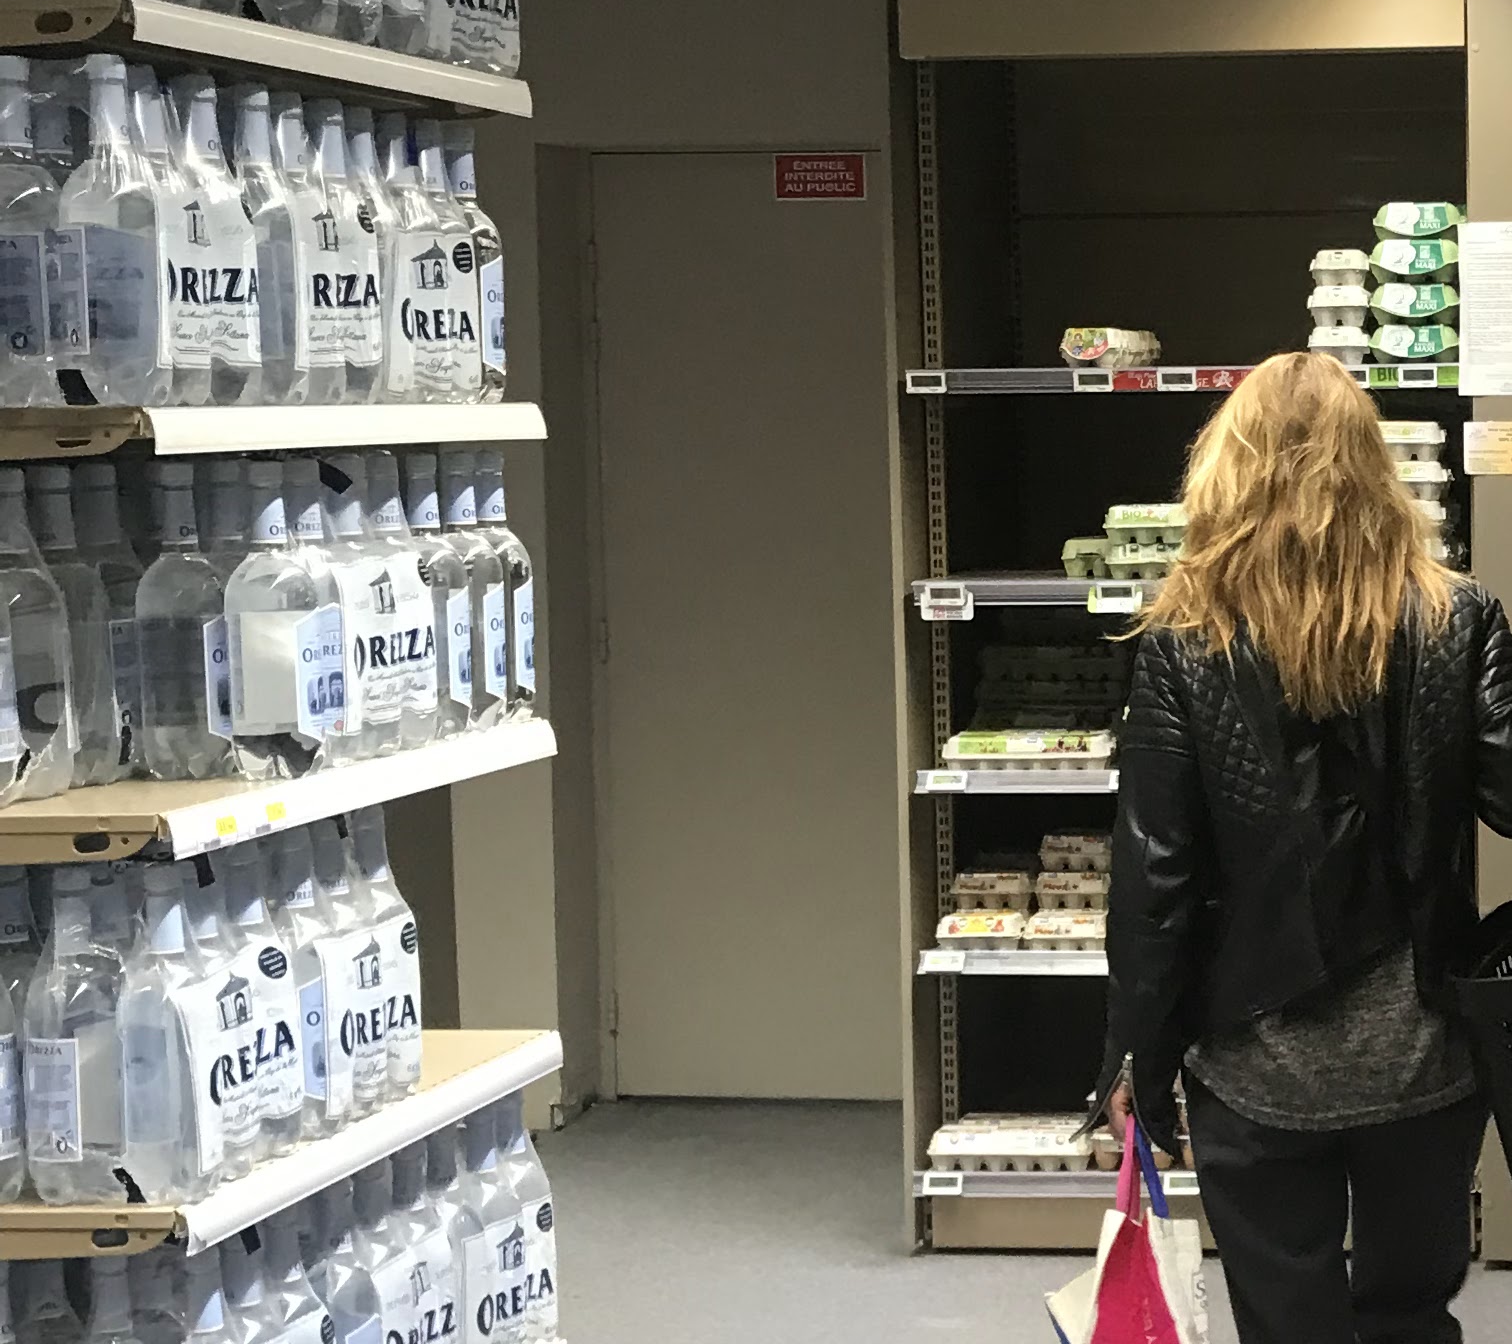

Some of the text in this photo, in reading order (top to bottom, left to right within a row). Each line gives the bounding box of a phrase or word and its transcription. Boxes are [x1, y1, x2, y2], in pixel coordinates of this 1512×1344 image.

[784, 171, 855, 181] INTERDITE
[784, 183, 856, 192] AU PUBLIC
[1419, 221, 1441, 230] MAXI
[1415, 261, 1437, 270] MAXI
[1415, 302, 1438, 311] MAXI
[1414, 345, 1436, 353] MAXI
[1121, 510, 1141, 521] BIO
